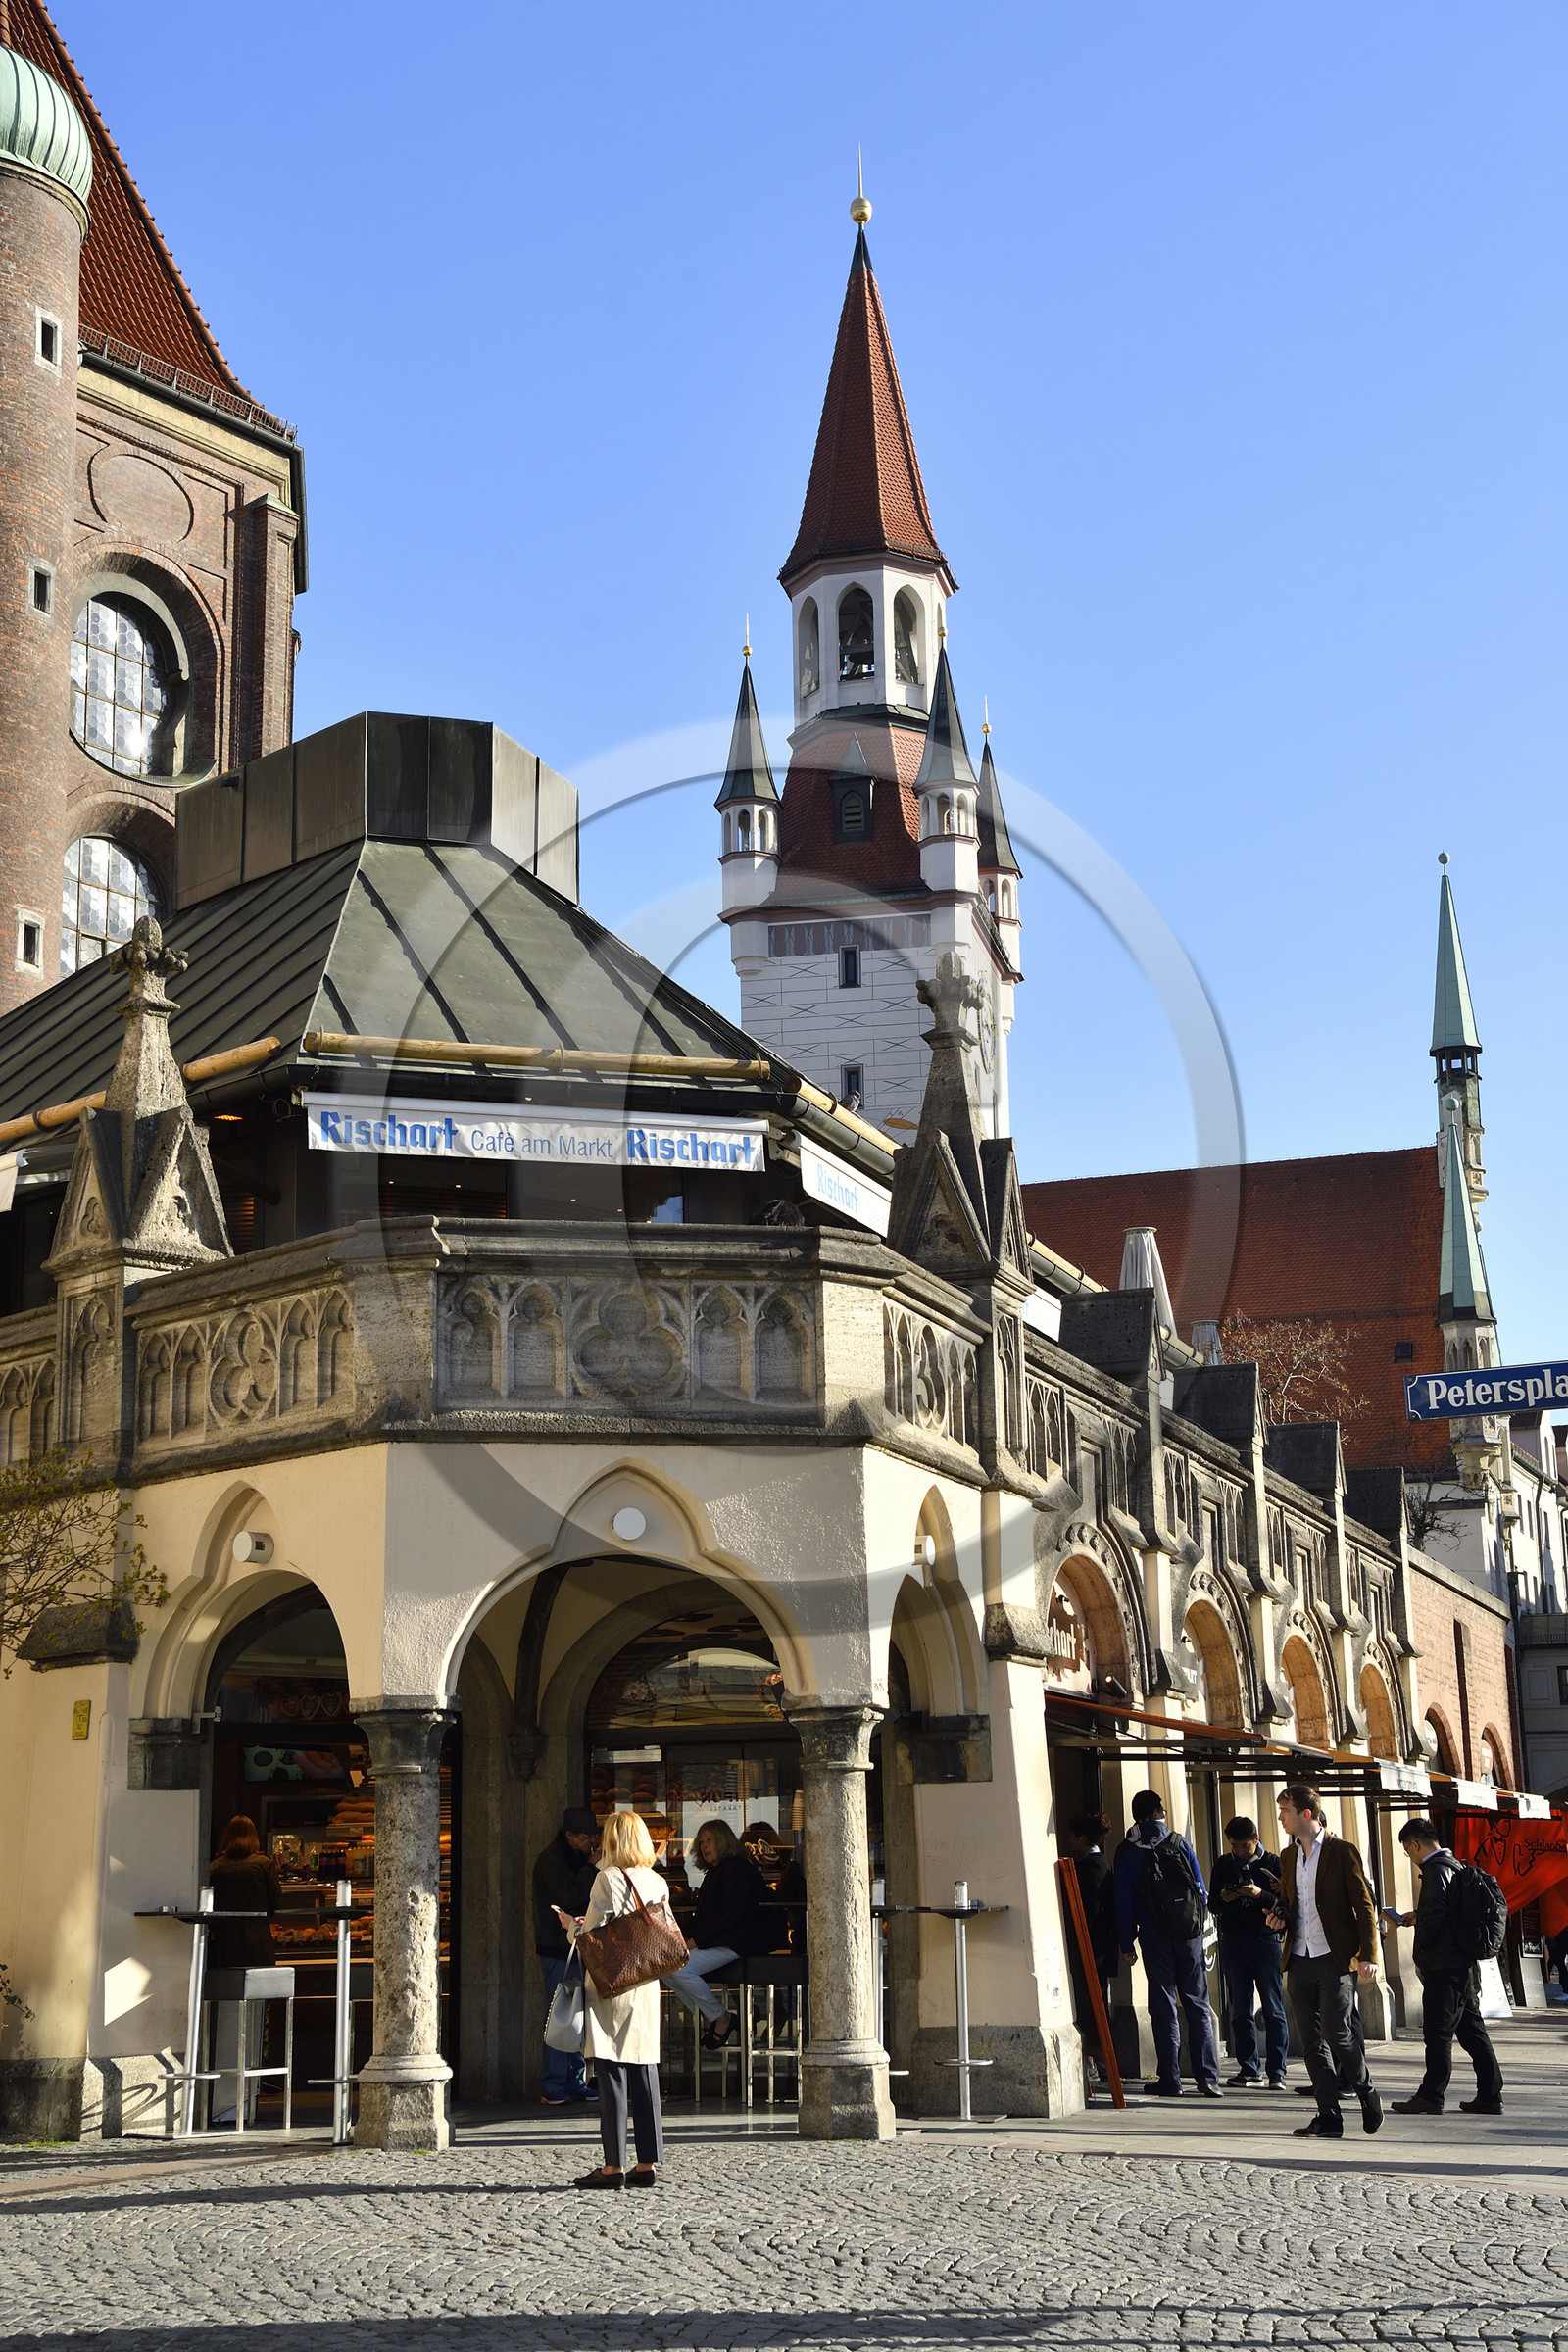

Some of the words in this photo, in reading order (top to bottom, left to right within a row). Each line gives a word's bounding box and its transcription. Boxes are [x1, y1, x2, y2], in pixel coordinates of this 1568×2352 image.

[320, 1110, 460, 1149] Rischart
[521, 1137, 552, 1154] am
[559, 1135, 613, 1158] Markt
[626, 1129, 756, 1164] Rischart
[816, 1163, 859, 1213] Rischart
